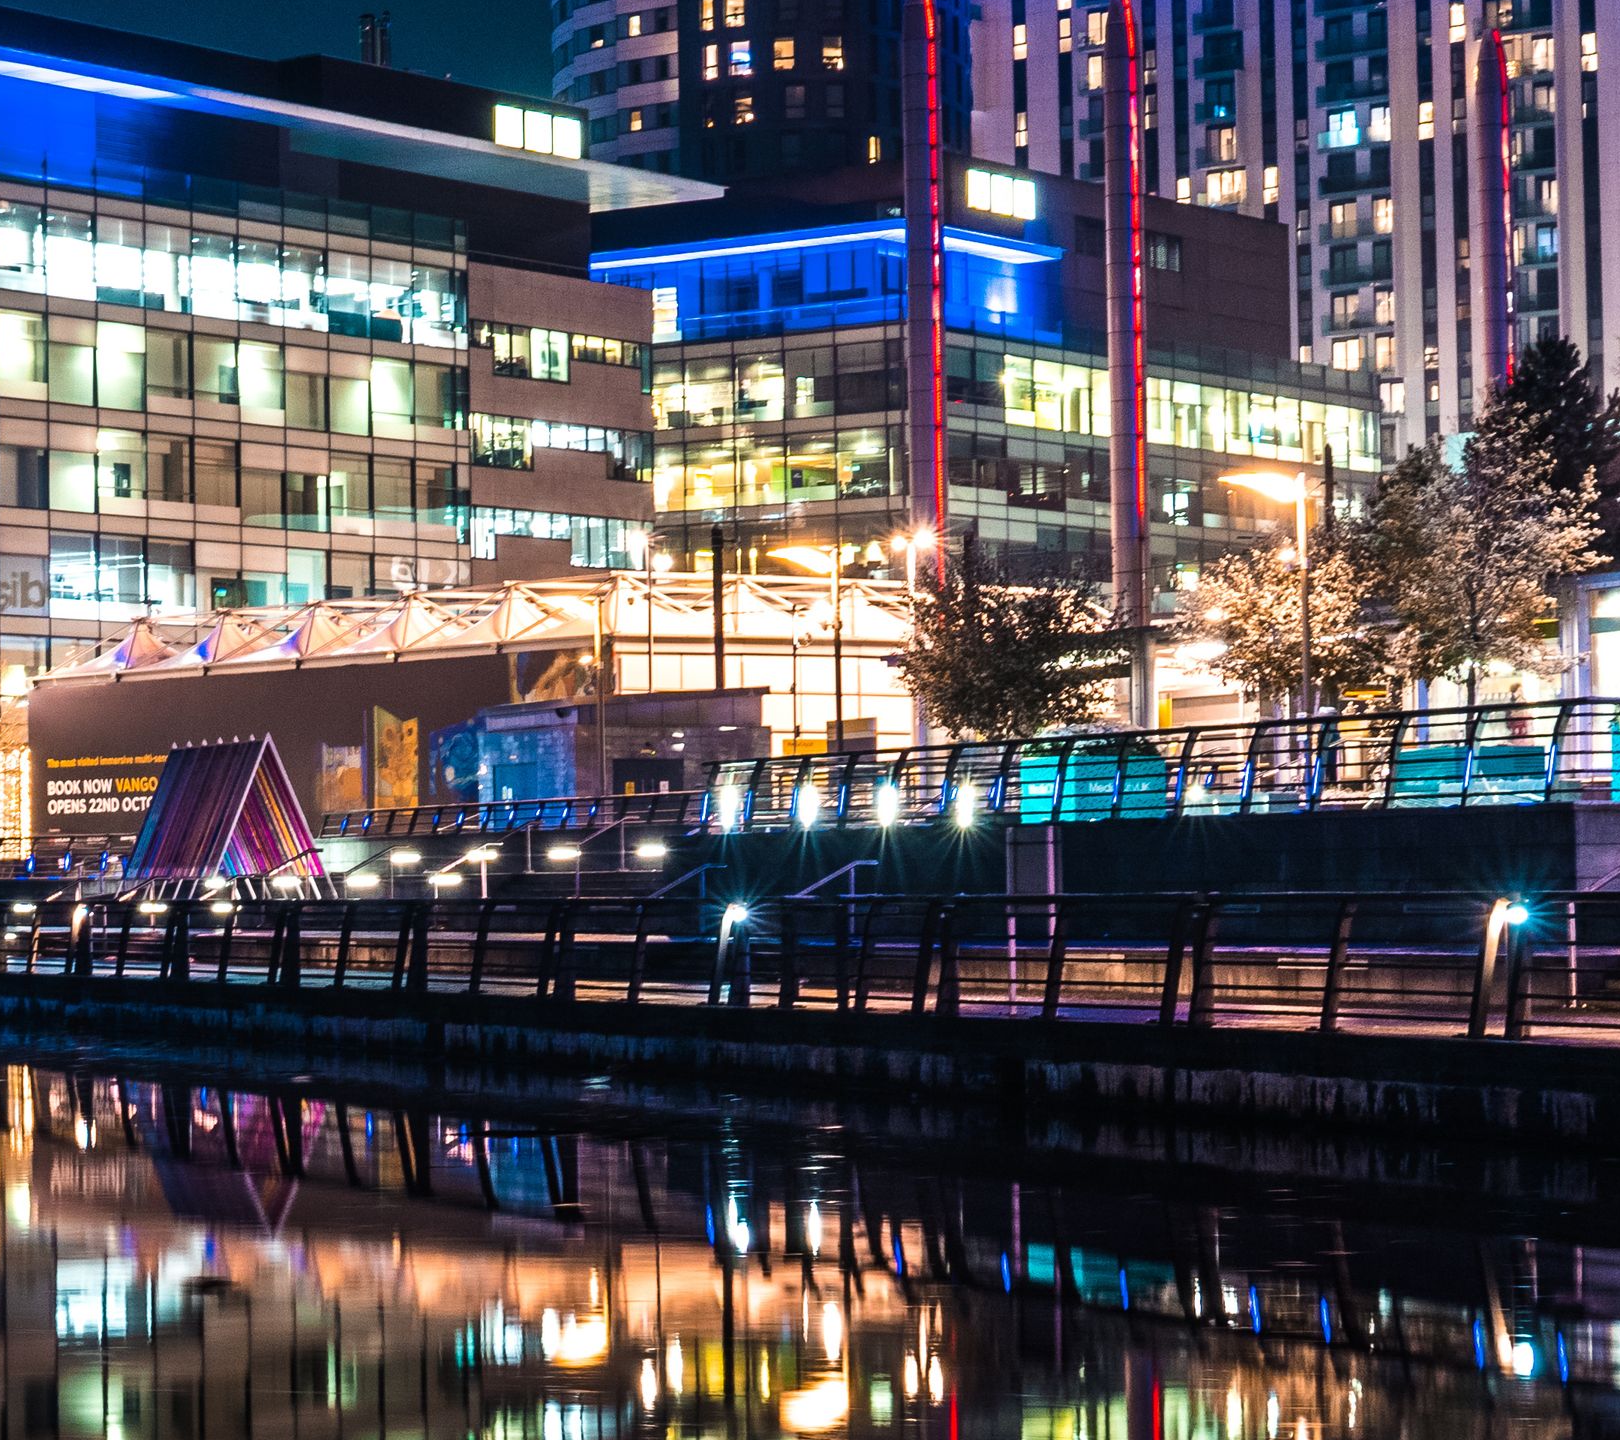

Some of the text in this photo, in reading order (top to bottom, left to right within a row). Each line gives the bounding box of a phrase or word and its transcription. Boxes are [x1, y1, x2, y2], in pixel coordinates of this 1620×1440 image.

[47, 780, 81, 796] BOOK
[83, 778, 113, 794] NOW
[47, 798, 86, 815] OPENS
[88, 797, 120, 813] 22ND
